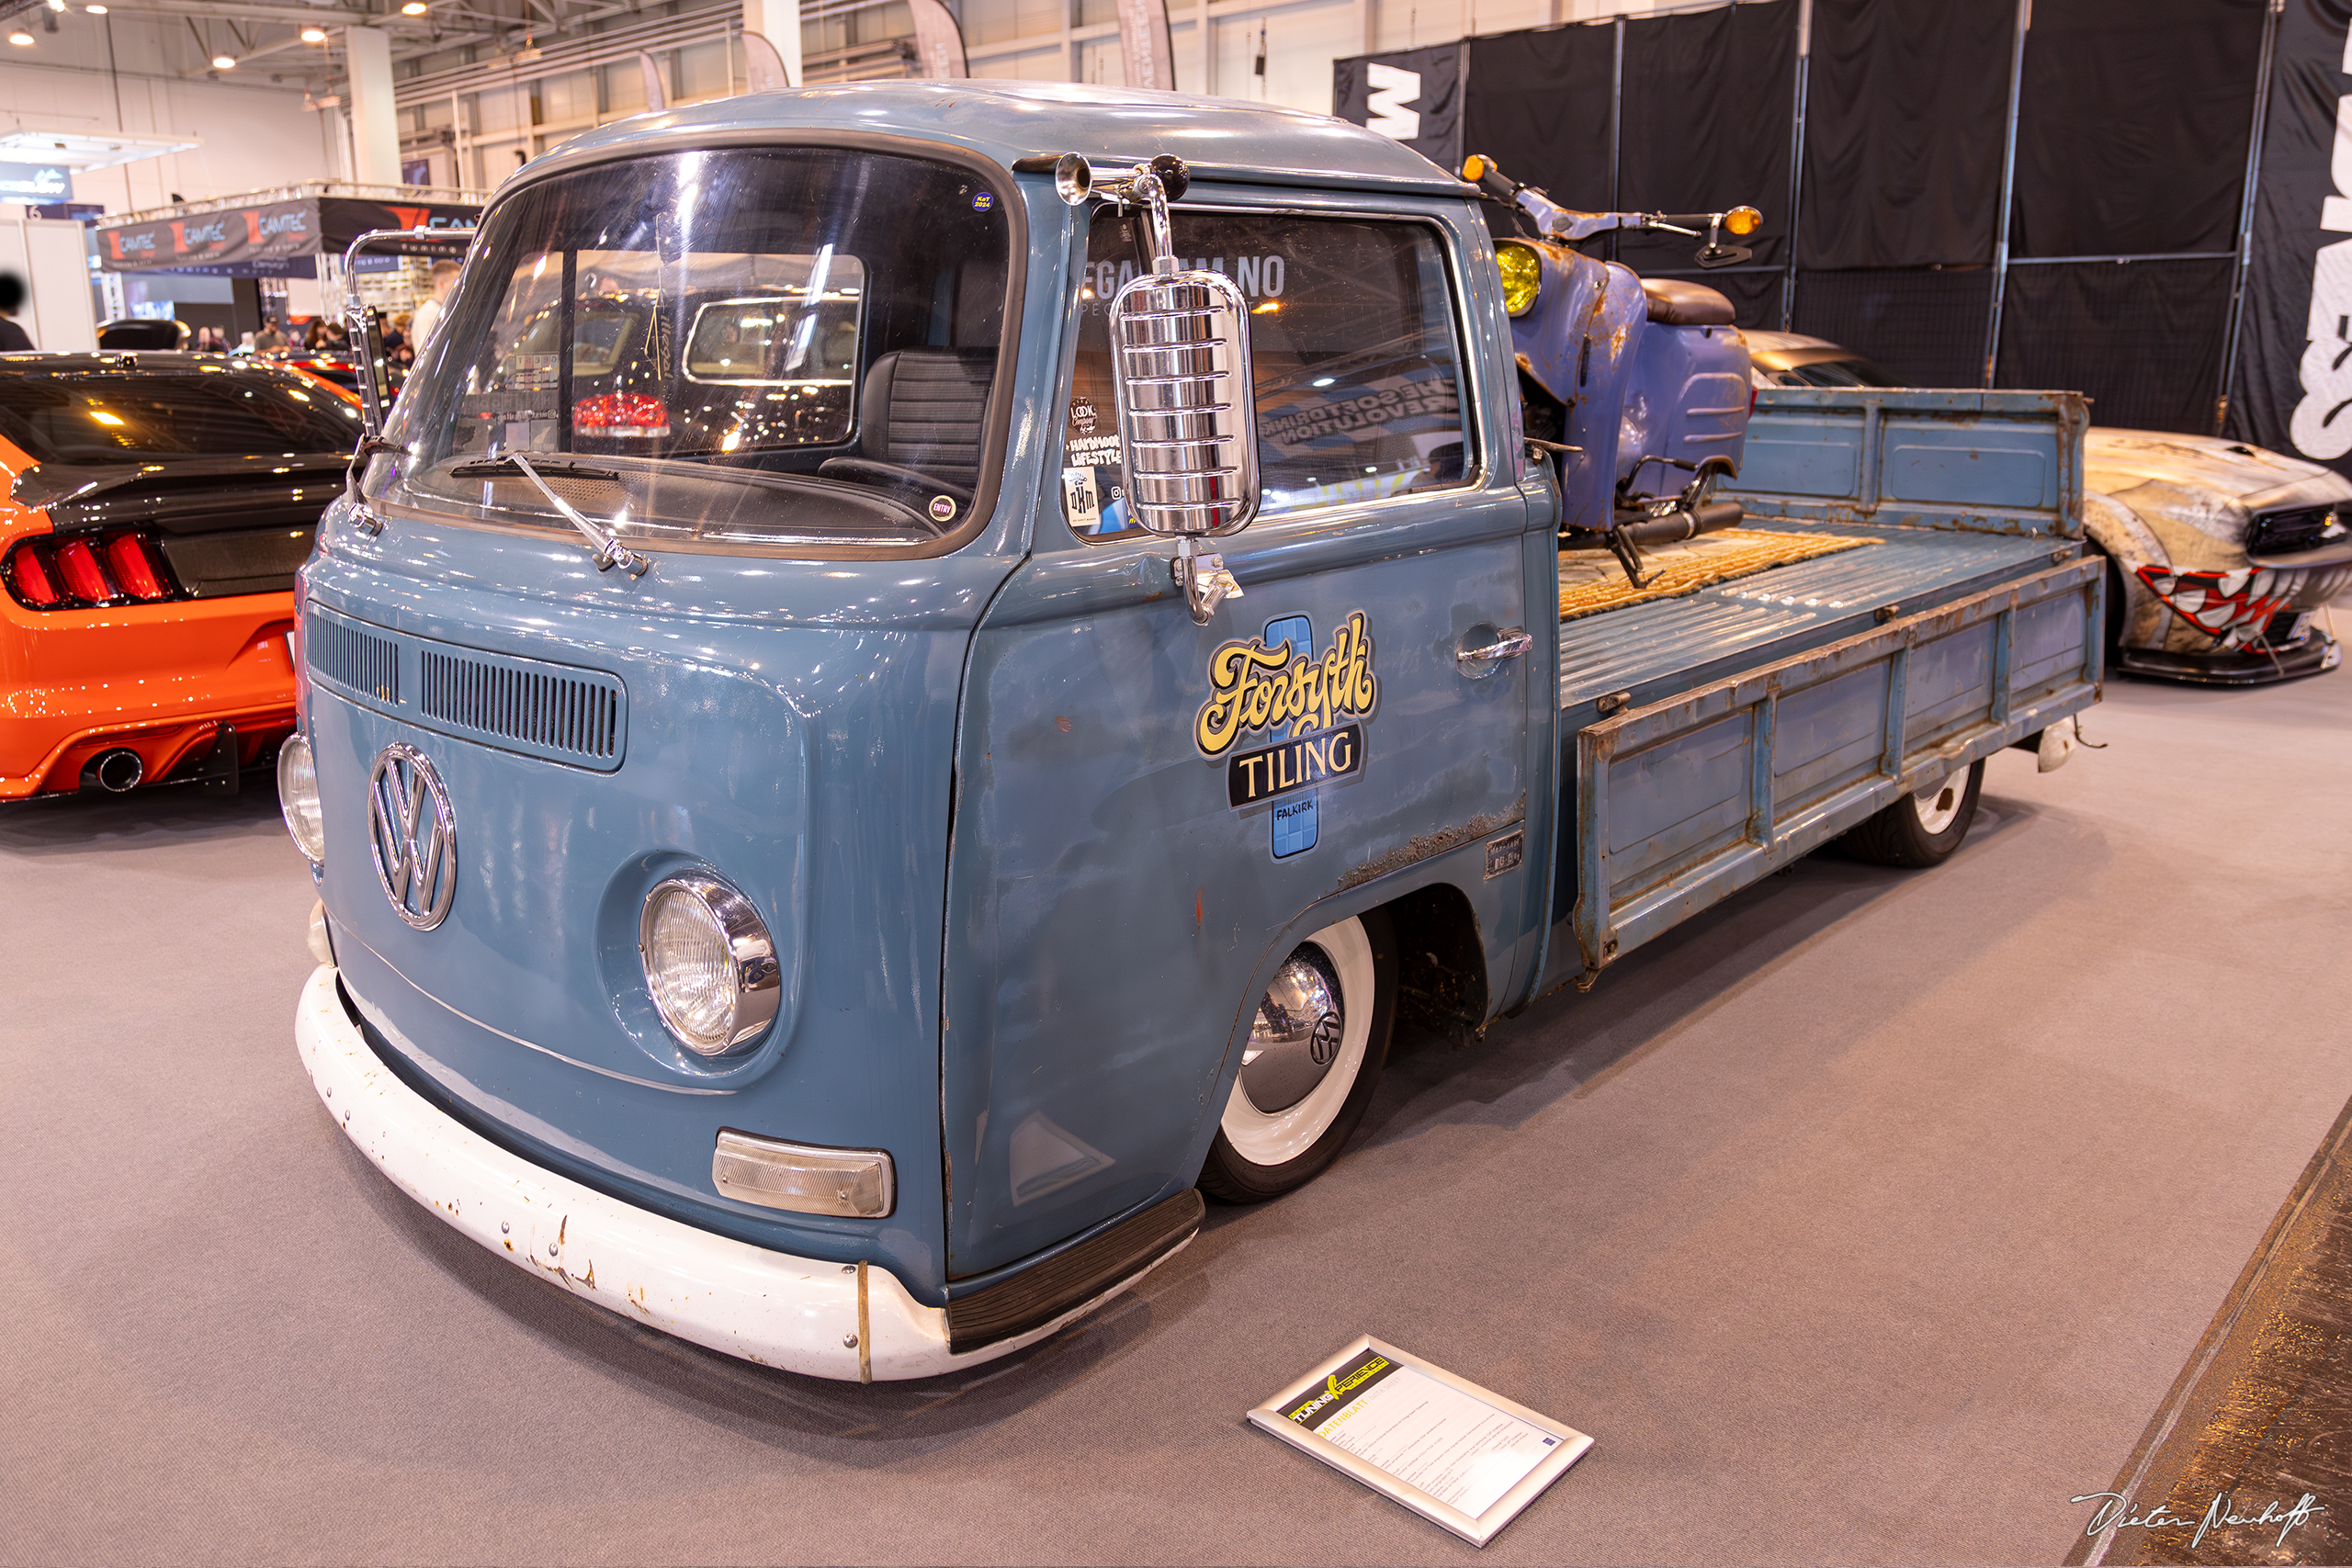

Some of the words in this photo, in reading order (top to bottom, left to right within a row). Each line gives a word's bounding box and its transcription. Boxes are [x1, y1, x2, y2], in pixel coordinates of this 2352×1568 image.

[933, 502, 951, 513] ENTRY
[1197, 611, 1375, 753] Forsyth
[1238, 731, 1351, 798] TILING
[1276, 799, 1314, 820] FALKIRK
[1317, 1398, 1368, 1438] DATENBLATT
